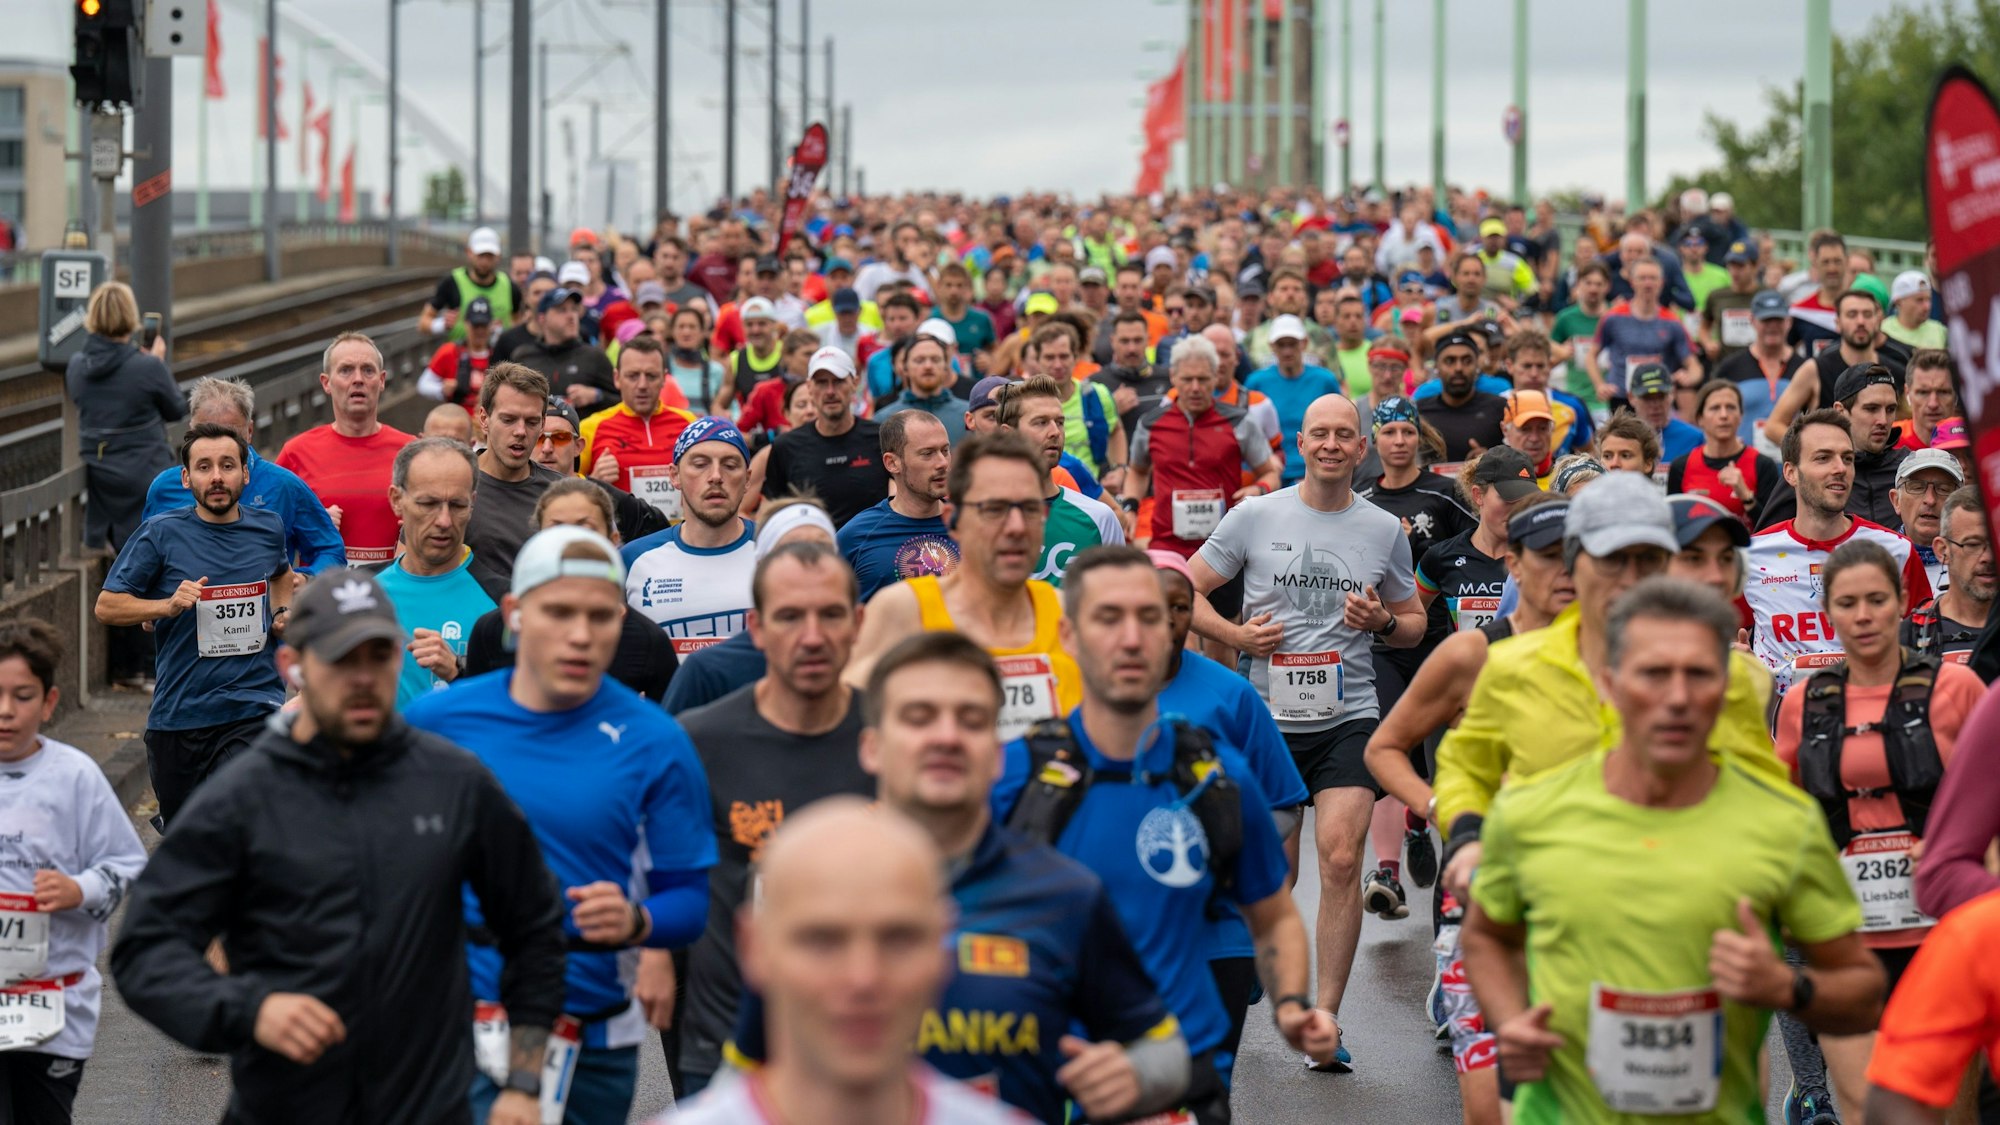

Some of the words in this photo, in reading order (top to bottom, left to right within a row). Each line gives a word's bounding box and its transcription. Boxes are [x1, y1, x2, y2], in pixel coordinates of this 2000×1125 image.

[59, 269, 87, 288] SF
[356, 551, 387, 559] GENERALI
[1273, 573, 1362, 593] MARATHON
[1762, 575, 1798, 585] uhlsport
[223, 586, 258, 597] GENERALI
[1458, 582, 1505, 594] MAC
[216, 602, 255, 619] 3573
[224, 625, 250, 635] Kamil
[1294, 655, 1330, 664] GENERALI
[1286, 670, 1327, 685] 1758
[1299, 692, 1315, 700] Ole
[1857, 858, 1911, 881] 2362
[1863, 889, 1909, 902] Liesbet
[917, 1007, 1039, 1055] ANKA
